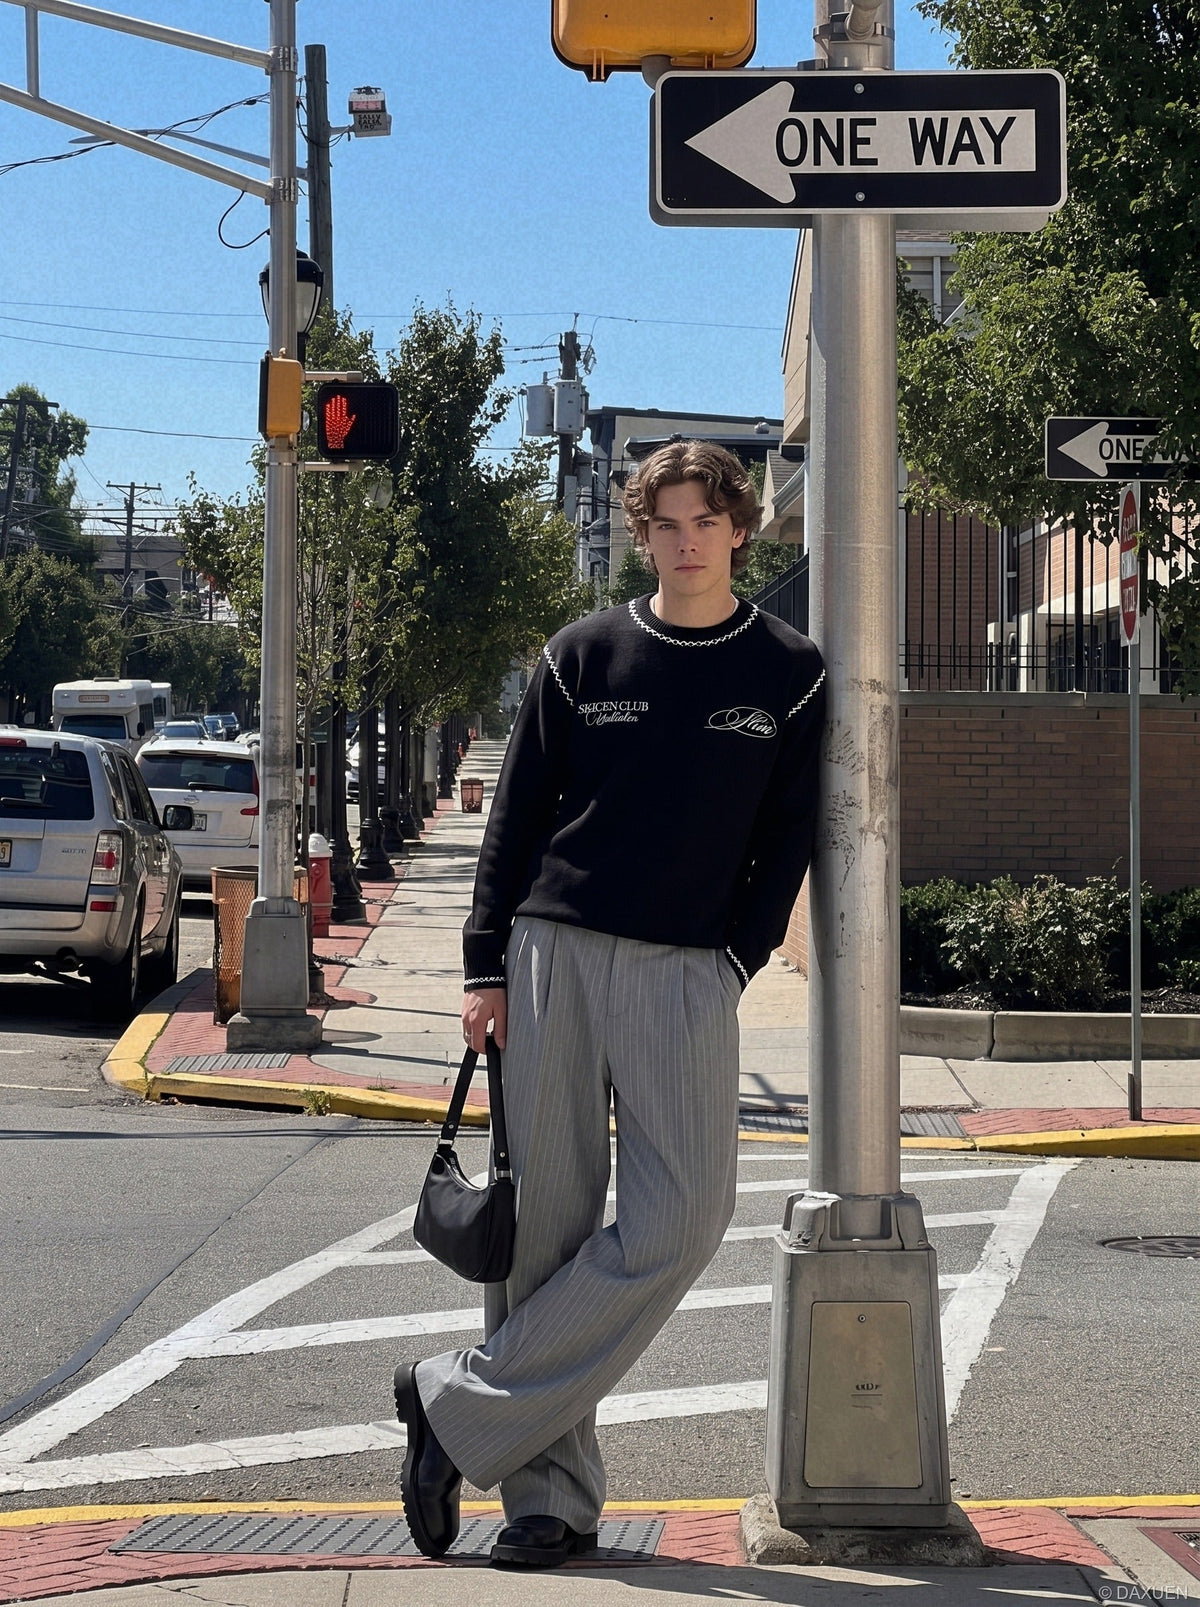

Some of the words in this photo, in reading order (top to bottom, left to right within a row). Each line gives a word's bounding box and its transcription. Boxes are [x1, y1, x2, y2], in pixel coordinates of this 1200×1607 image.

[775, 117, 878, 168] ONE
[908, 116, 1017, 166] WAY
[1099, 438, 1145, 461] ONE
[618, 701, 649, 712] CLUB
